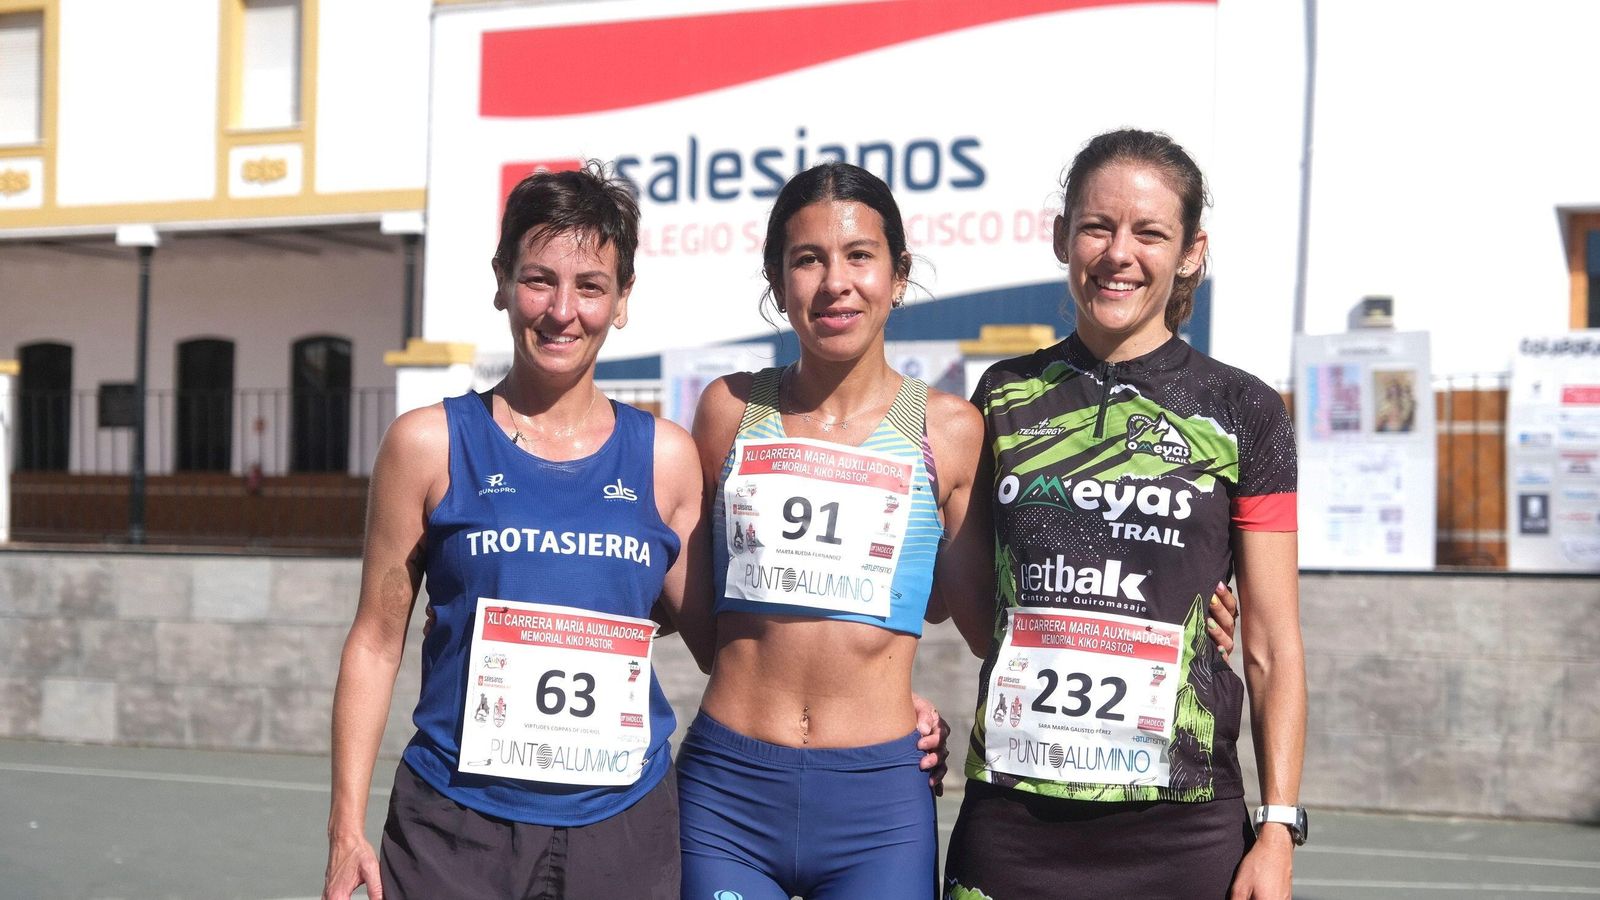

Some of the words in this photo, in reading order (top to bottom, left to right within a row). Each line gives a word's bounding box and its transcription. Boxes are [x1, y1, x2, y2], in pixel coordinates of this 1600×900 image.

[745, 450, 759, 461] XLI
[759, 448, 801, 461] CARRERA
[1165, 456, 1189, 465] TRAIL
[771, 461, 812, 475] MEMORIAL
[813, 465, 834, 478] KIKO
[782, 496, 842, 545] 91
[1109, 521, 1185, 548] TRAIL
[466, 527, 651, 567] TROTASIERRA
[1055, 594, 1068, 603] de
[1073, 596, 1147, 613] Quiromasaje
[487, 612, 502, 625] XLI
[504, 613, 553, 630] CARRERA
[1015, 617, 1028, 631] XLI
[1028, 619, 1066, 632] CARRERA
[520, 629, 564, 645] MEMORIAL
[565, 634, 584, 646] KIKO
[1041, 634, 1076, 646] MEMORIAL
[1077, 637, 1098, 649] KIKO
[536, 669, 596, 718] 63
[1031, 668, 1127, 721] 232
